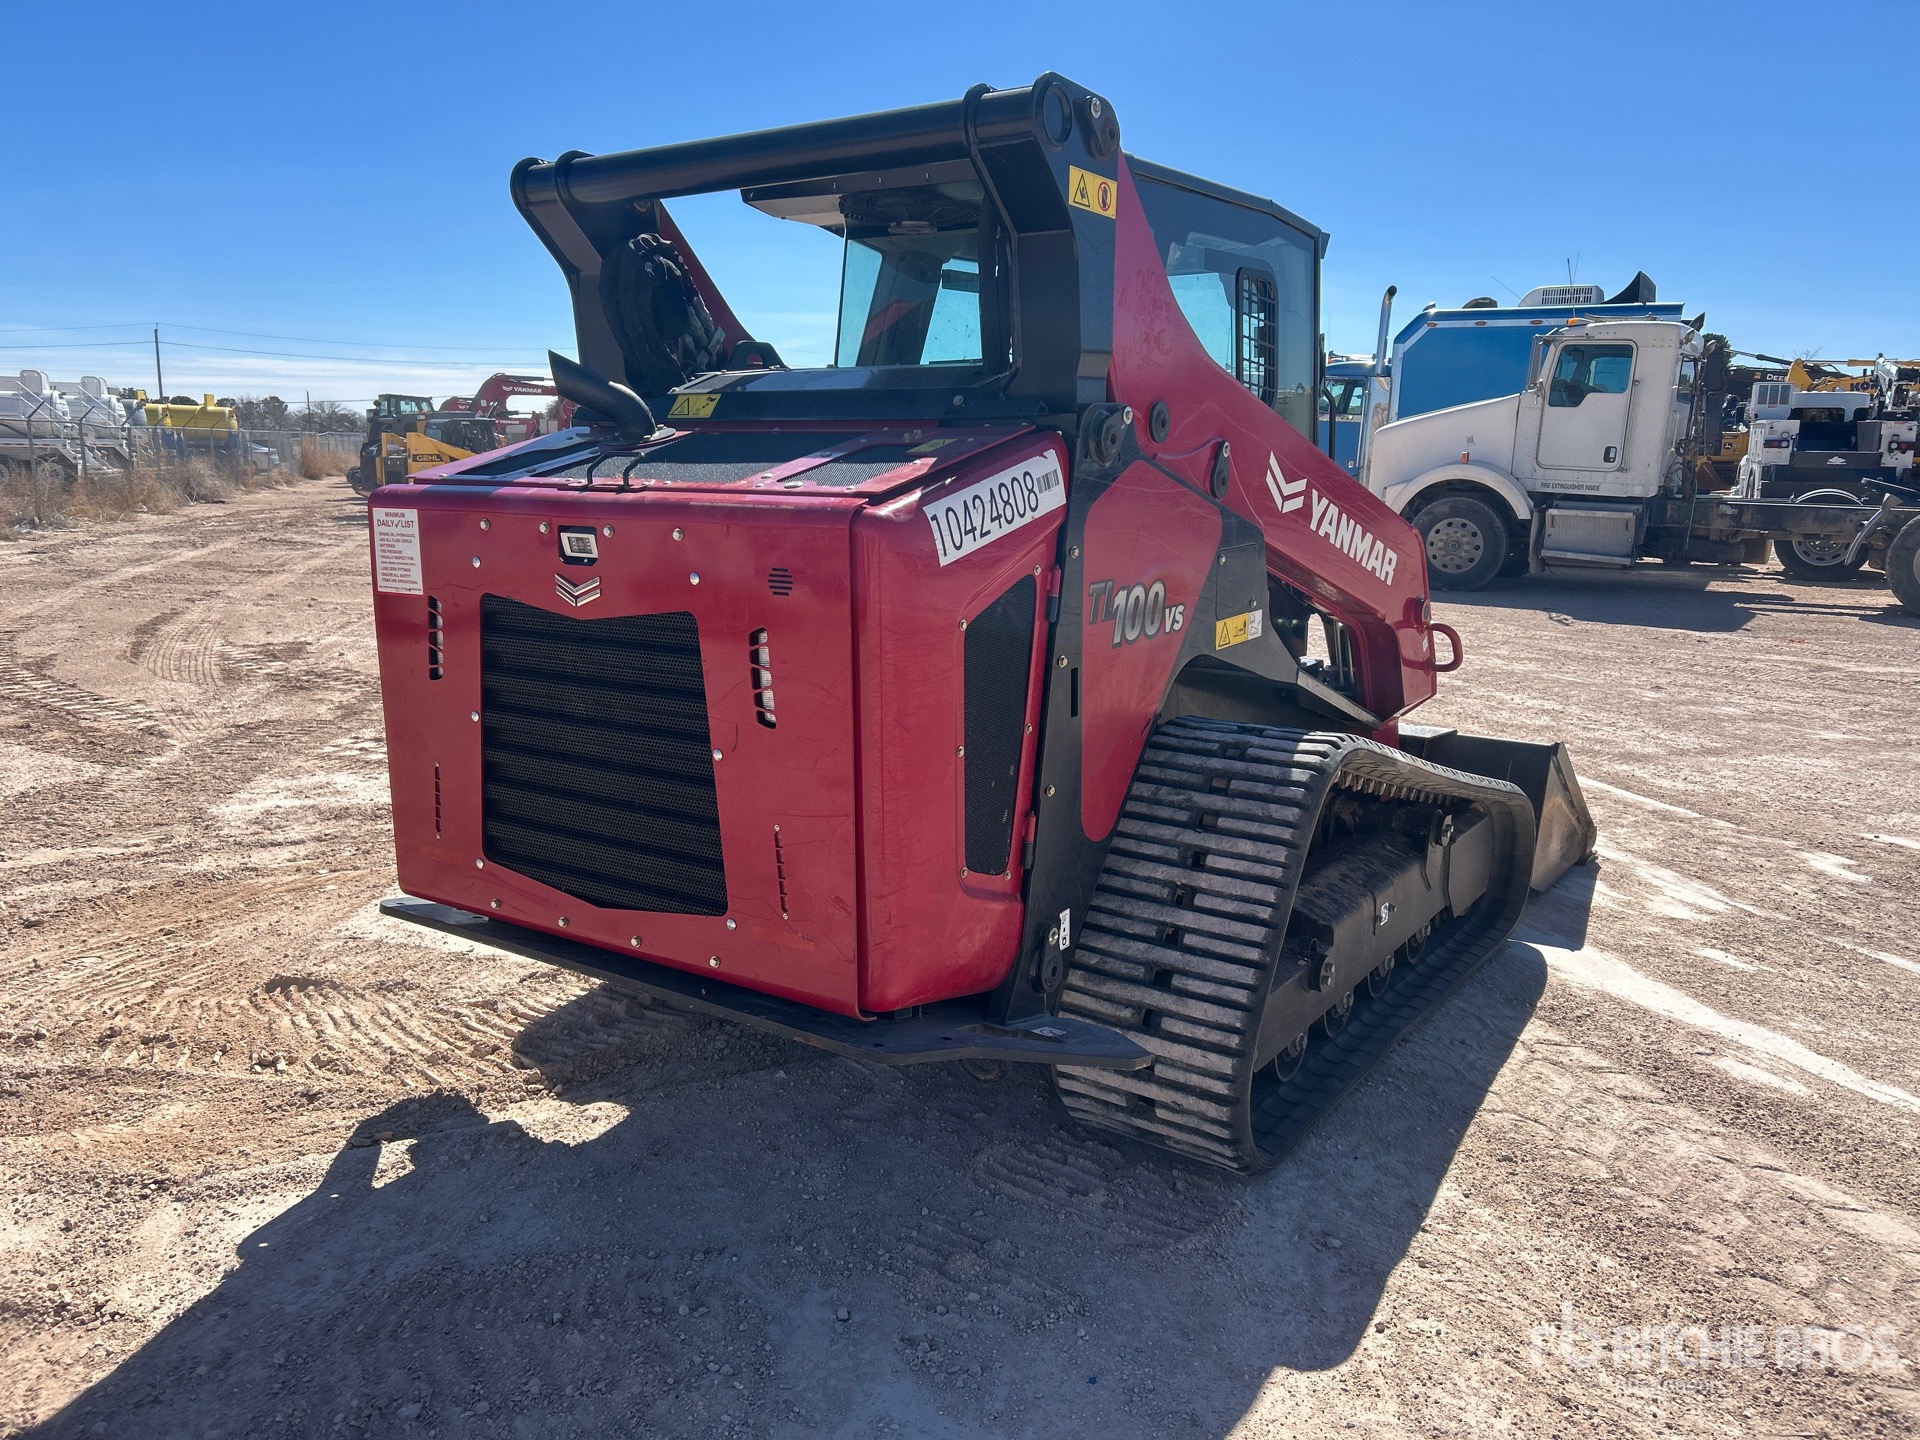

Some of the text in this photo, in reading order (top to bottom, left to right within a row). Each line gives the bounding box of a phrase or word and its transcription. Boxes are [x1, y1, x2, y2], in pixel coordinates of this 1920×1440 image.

[513, 386, 542, 394] YANMAR
[1551, 482, 1584, 490] EXTINGUISHER
[930, 470, 1039, 557] 10424808
[377, 519, 415, 529] DAILY LIST
[1309, 488, 1398, 586] YANMAR
